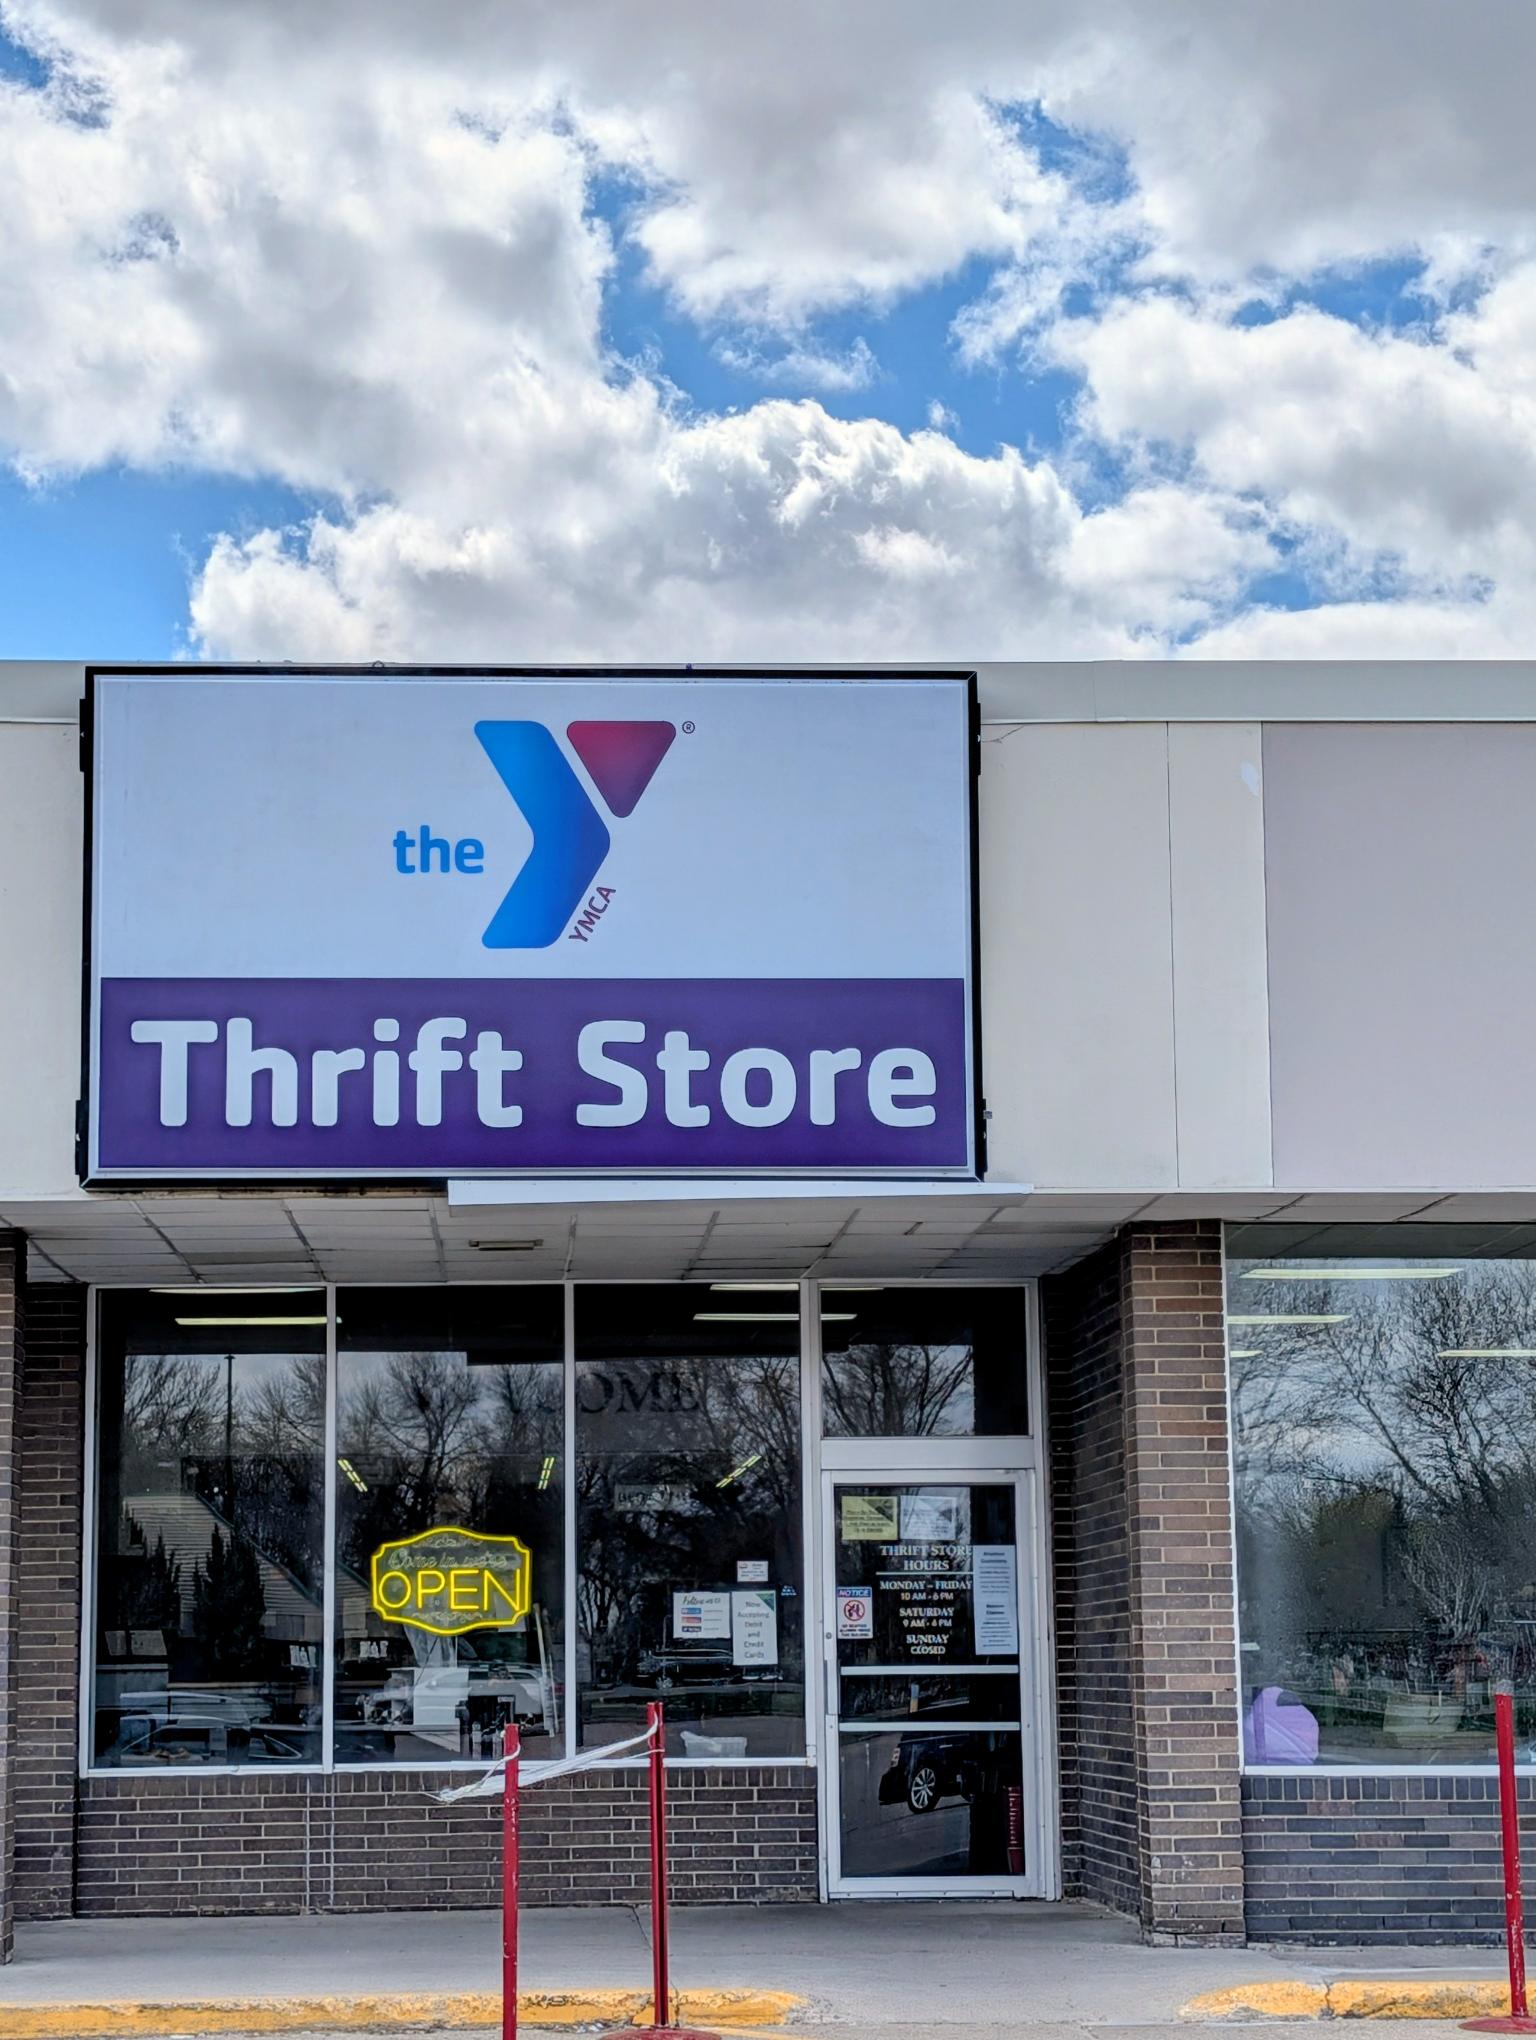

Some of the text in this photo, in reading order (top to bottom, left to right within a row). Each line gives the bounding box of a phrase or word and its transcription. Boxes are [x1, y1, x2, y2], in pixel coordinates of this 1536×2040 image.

[393, 825, 485, 874] the
[568, 886, 617, 942] YMCA
[131, 1017, 937, 1128] Thrift Store
[879, 1545, 973, 1556] THRIFT STORE
[903, 1560, 950, 1571] HOURS
[378, 1568, 521, 1612] OPEN
[880, 1581, 926, 1590] MONDAY
[935, 1581, 972, 1590] FRIDAY
[901, 1592, 910, 1600] 10
[912, 1592, 926, 1600] AM
[933, 1592, 939, 1600] 6
[940, 1592, 954, 1600] PM
[899, 1607, 954, 1617] SATURDAY
[903, 1619, 909, 1627] 9
[910, 1619, 925, 1627] AM
[938, 1619, 952, 1627] PM
[906, 1634, 949, 1644] SUNDAY
[910, 1646, 946, 1655] CLOSED
